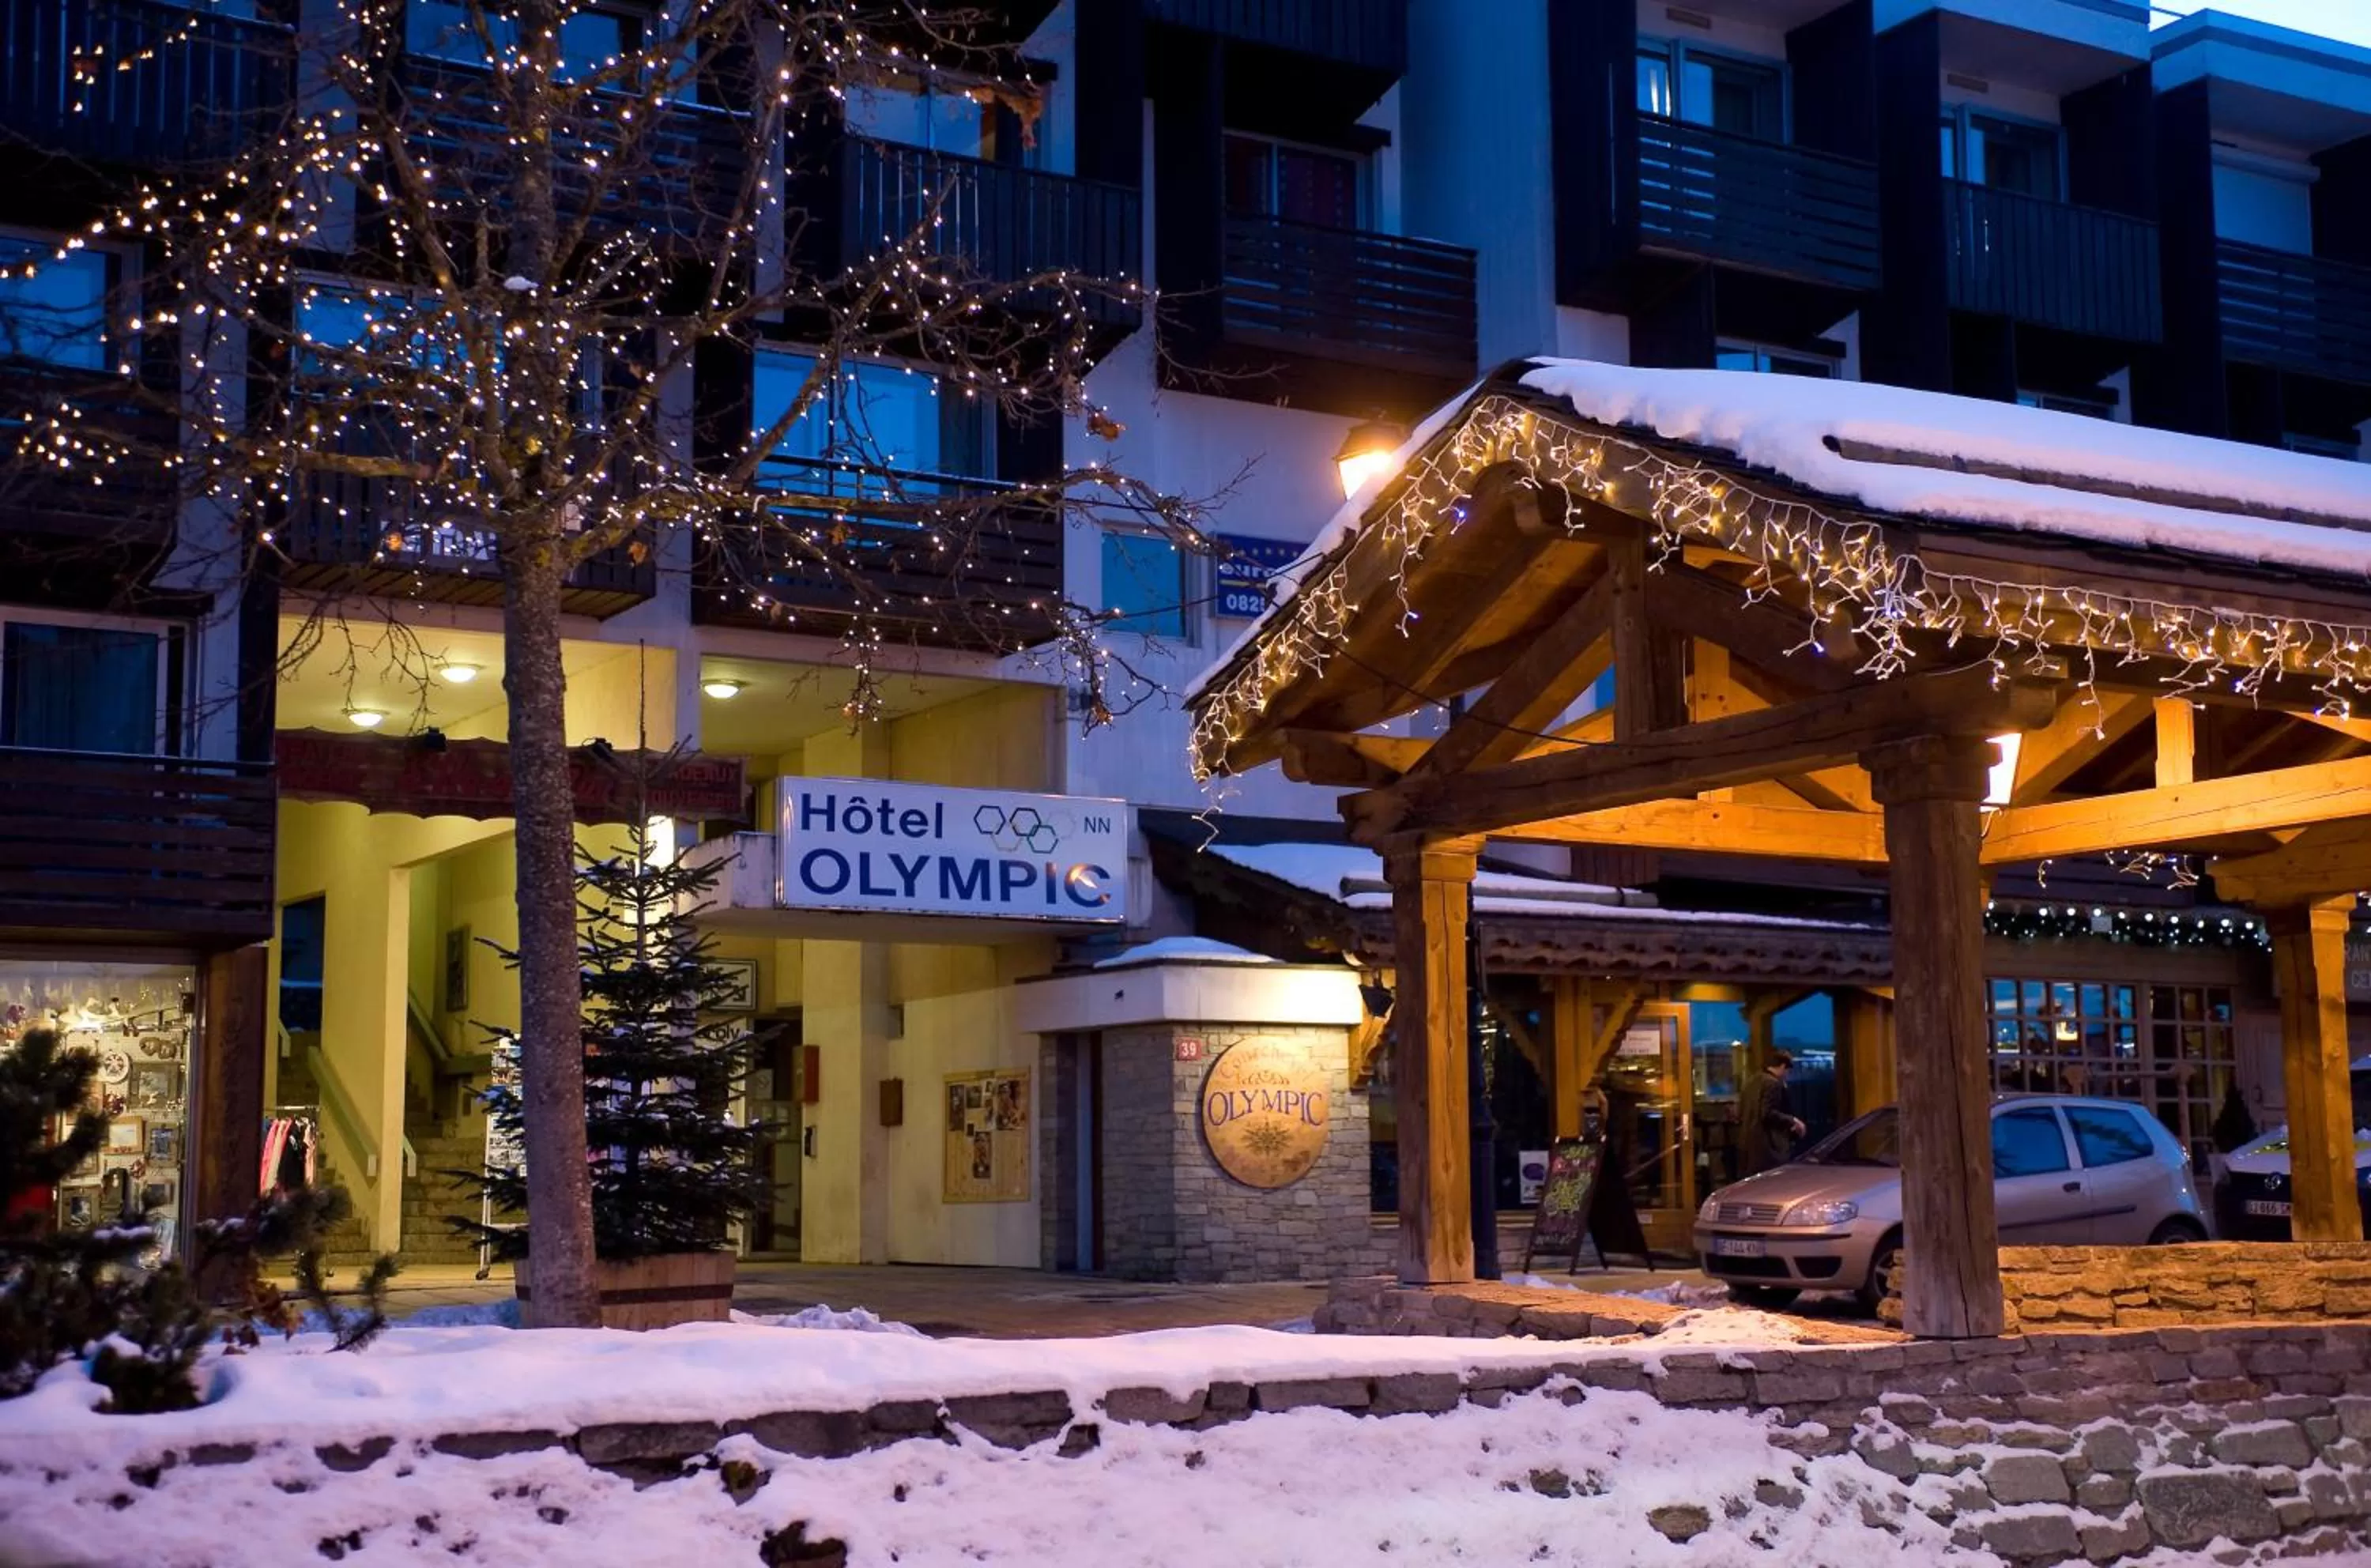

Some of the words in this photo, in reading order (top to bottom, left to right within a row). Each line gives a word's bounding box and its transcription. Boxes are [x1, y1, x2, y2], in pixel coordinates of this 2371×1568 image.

[800, 793, 944, 839] Hôtel
[1084, 816, 1110, 835] NN
[799, 847, 1112, 909] OLYMPIC
[1181, 1042, 1197, 1057] 39
[1208, 1088, 1324, 1127] OLYMPIC
